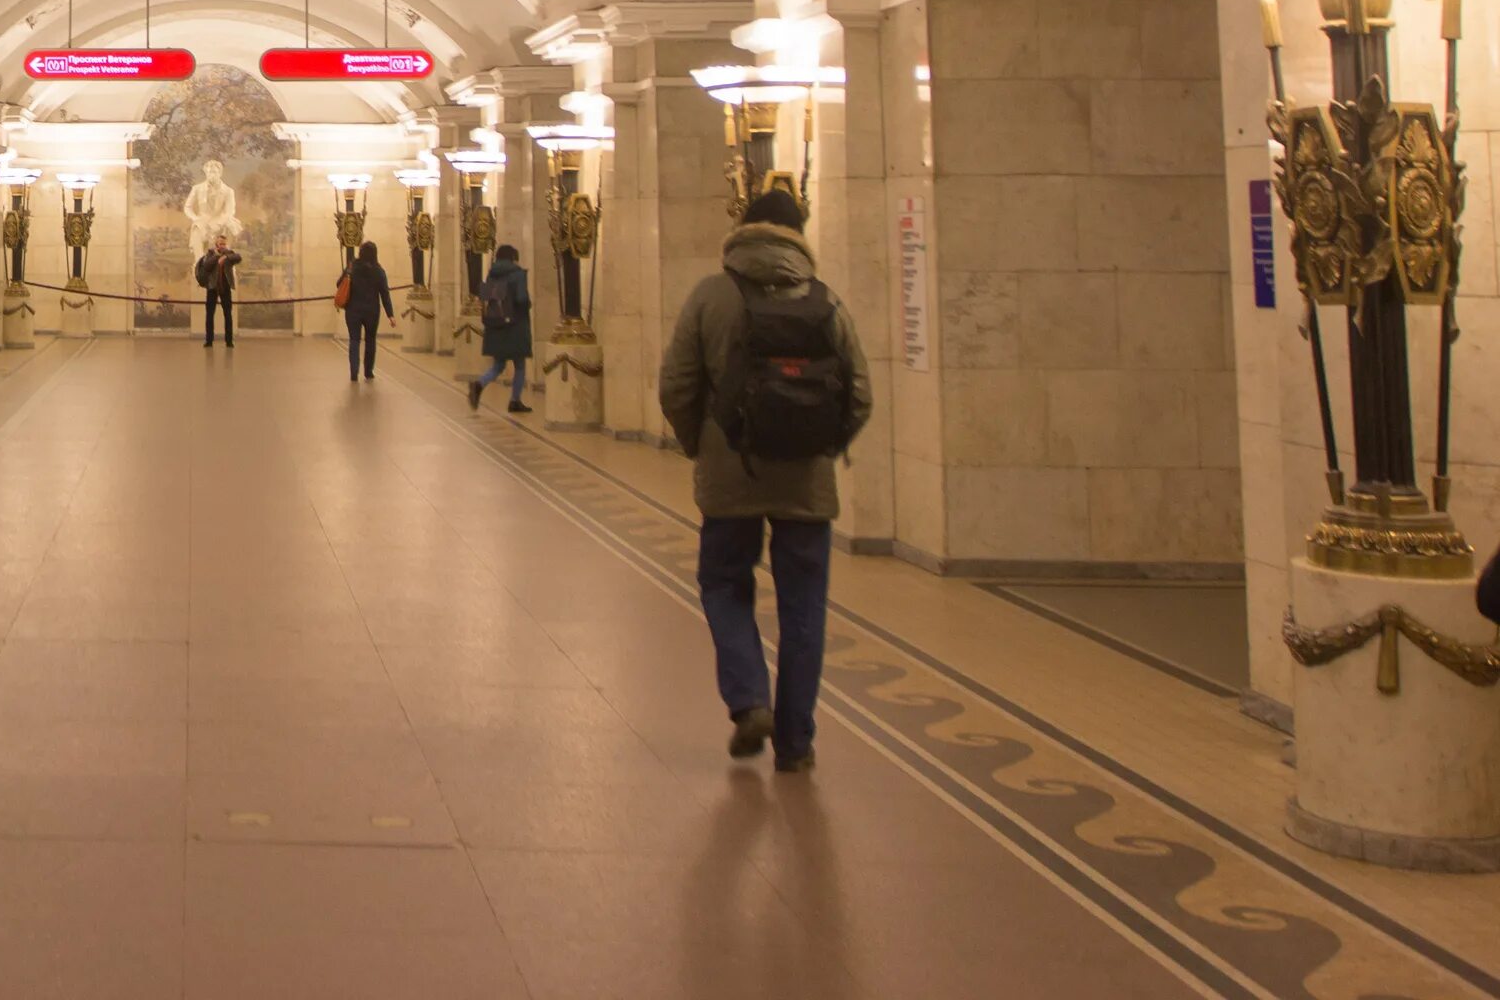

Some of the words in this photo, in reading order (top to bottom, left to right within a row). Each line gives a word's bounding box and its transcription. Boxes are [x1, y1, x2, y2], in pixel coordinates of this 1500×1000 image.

[68, 55, 107, 65] Проспект
[108, 55, 152, 65] Ветеранов
[343, 54, 390, 63] Девяткино
[68, 66, 100, 74] Prospekt
[347, 65, 390, 74] Devyatkino
